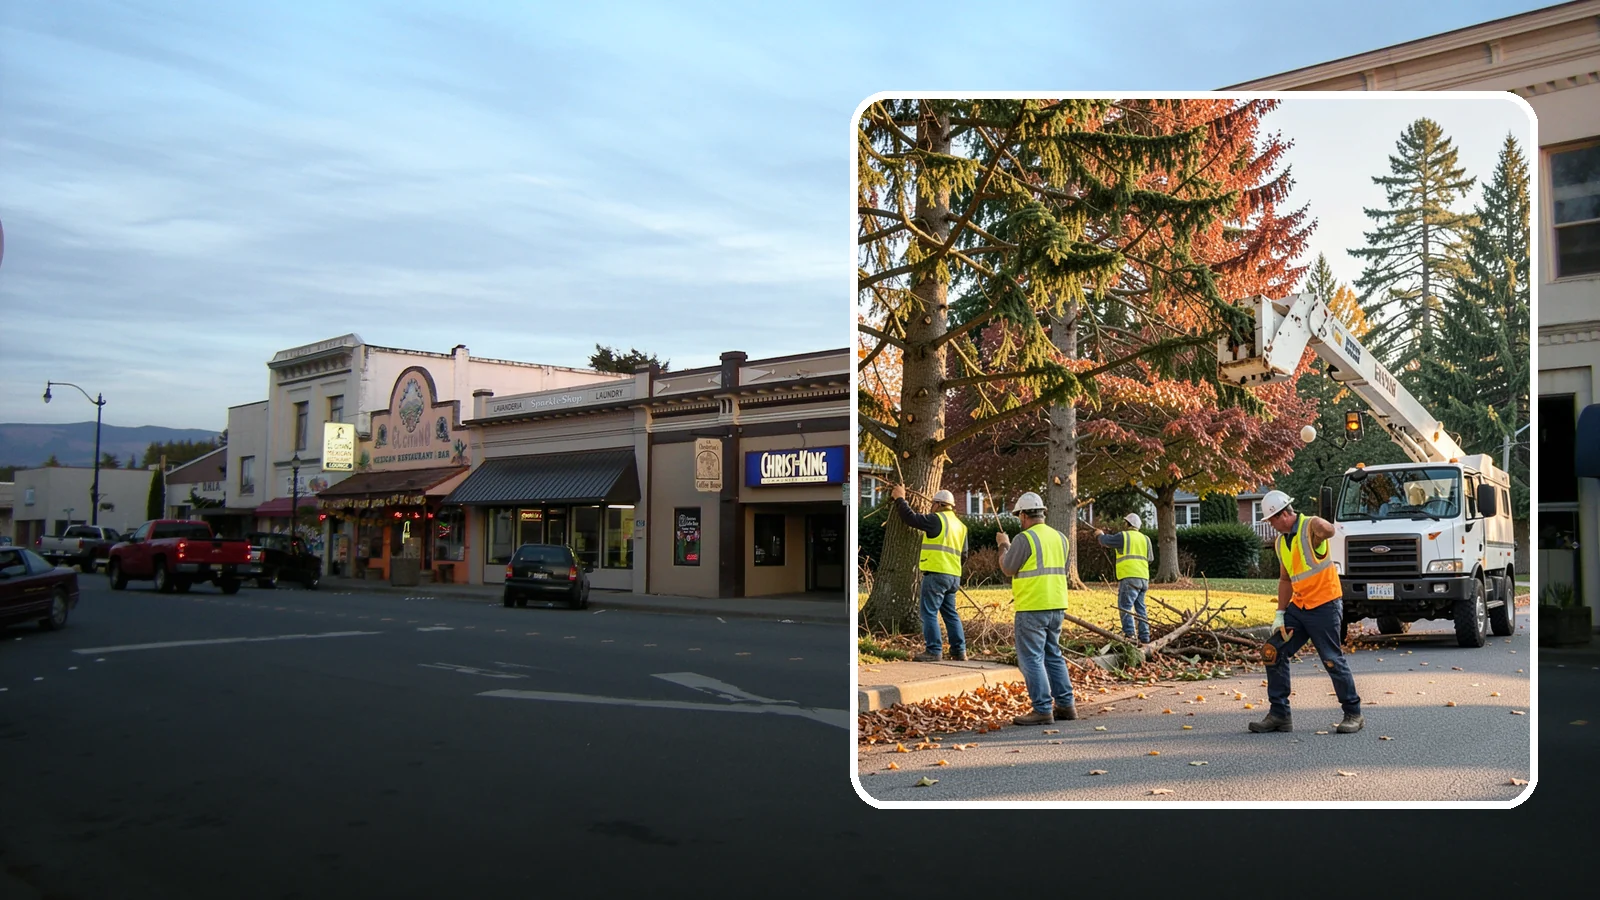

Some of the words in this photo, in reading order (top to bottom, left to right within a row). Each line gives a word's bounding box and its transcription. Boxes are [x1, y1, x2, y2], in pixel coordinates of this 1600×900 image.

[596, 389, 623, 399] LAUNDRY
[494, 402, 522, 412] LAVANDERIA
[531, 396, 560, 409] Sparkle
[562, 394, 582, 405] Shop
[373, 455, 396, 464] MEXICAN
[398, 451, 433, 462] RESTAURANT
[438, 450, 450, 459] BAR
[761, 452, 797, 477] CHRIST
[799, 450, 827, 476] KING
